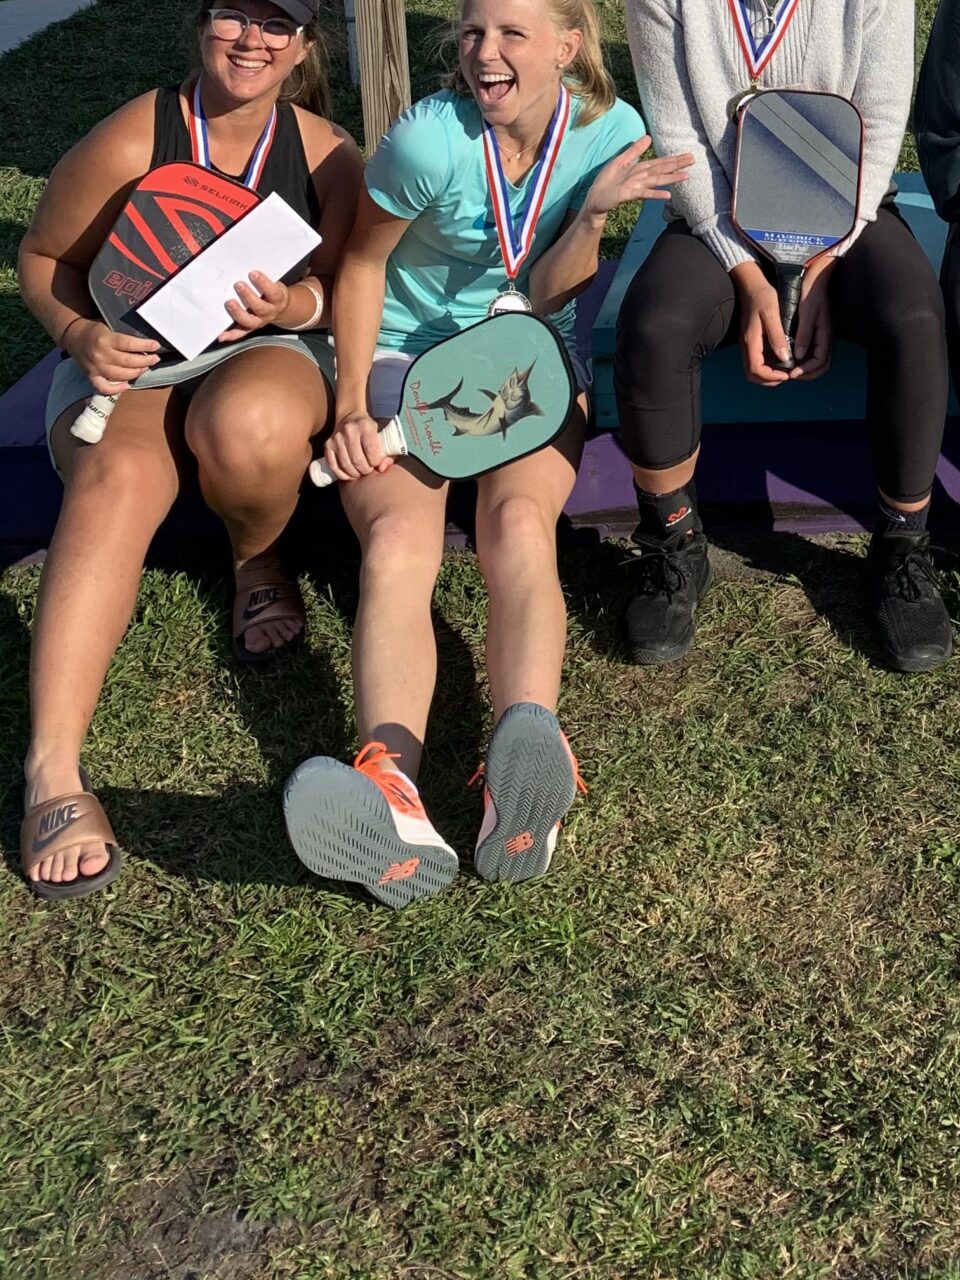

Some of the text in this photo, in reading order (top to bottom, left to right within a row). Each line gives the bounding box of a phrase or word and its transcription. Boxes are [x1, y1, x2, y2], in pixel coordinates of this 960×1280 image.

[200, 185, 249, 210] SELKIRK
[764, 232, 825, 245] MAVERICK
[249, 587, 281, 608] NIKE
[38, 802, 79, 837] NIKE
